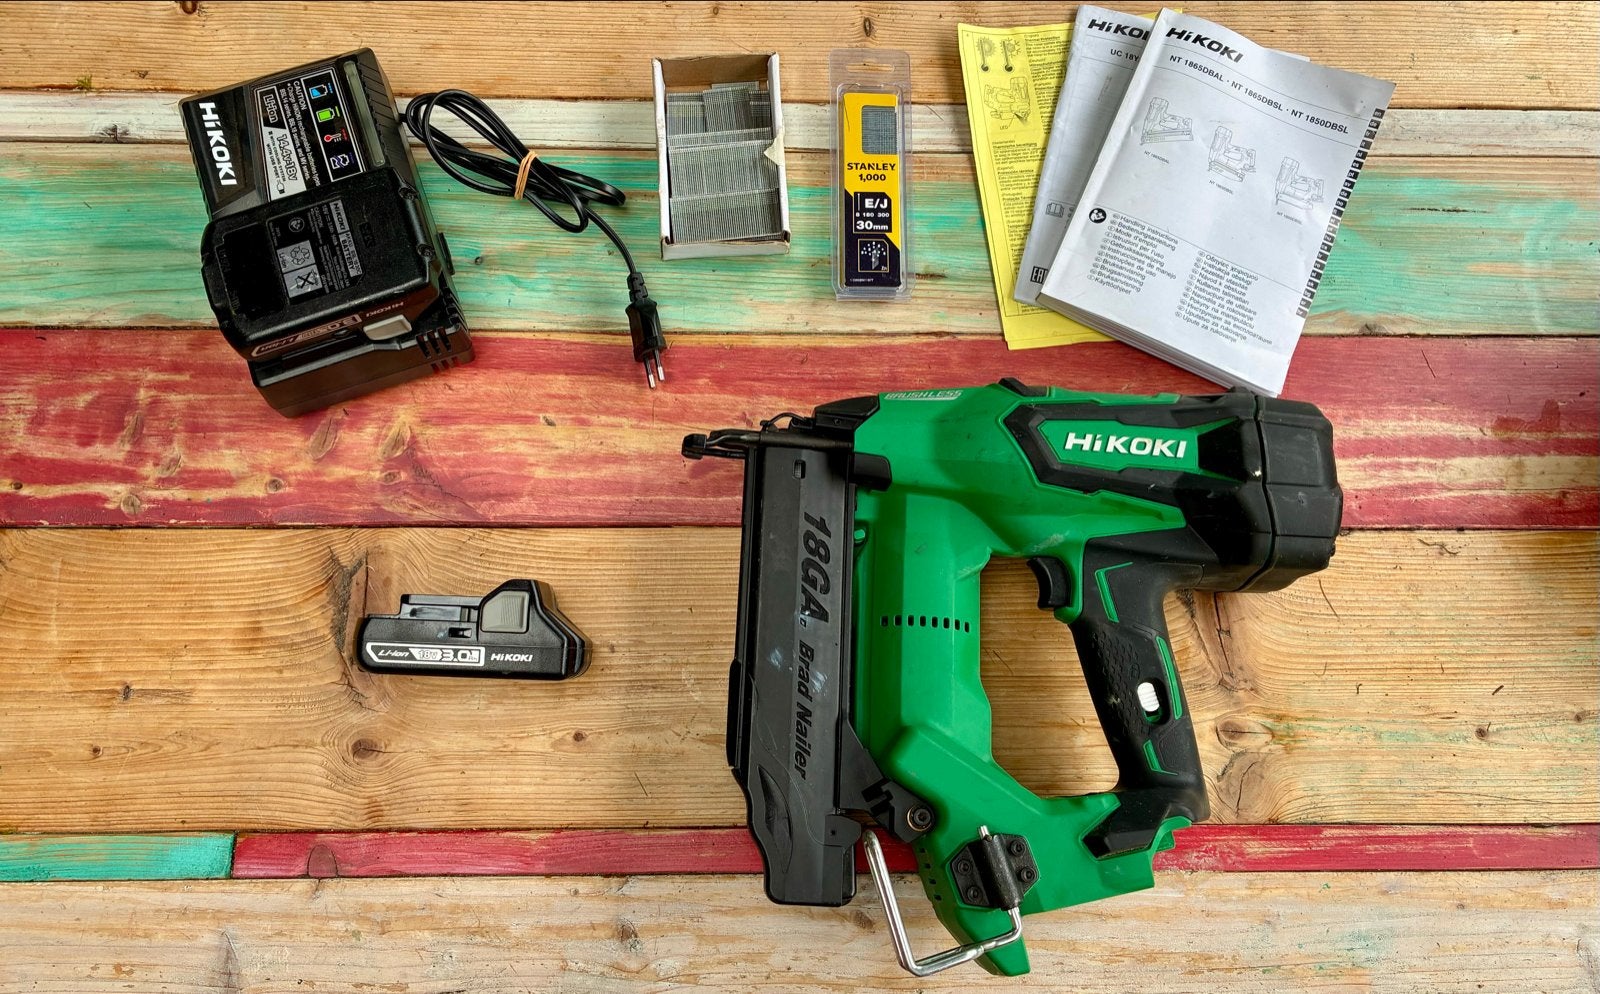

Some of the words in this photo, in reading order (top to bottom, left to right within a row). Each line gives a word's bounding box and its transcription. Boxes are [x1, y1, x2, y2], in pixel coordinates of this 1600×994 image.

[1110, 48, 1123, 57] UC
[1166, 27, 1244, 63] HiKOKI
[292, 80, 307, 110] CAUTION
[1169, 54, 1182, 63] NT
[1185, 59, 1224, 82] 1865DBAL
[1231, 80, 1244, 91] NT
[1244, 87, 1284, 111] 1865DBSL
[1290, 109, 1304, 120] NT
[1305, 114, 1349, 134] 1850DBSL
[263, 93, 279, 123] Li-ion
[199, 102, 237, 186] HiKOKI
[273, 146, 281, 165] COOLING
[278, 165, 286, 181] SYSTEM
[847, 162, 896, 170] STANLEY
[859, 174, 886, 182] 1,000
[865, 198, 888, 209] E/J
[856, 220, 888, 230] 30mm
[1115, 227, 1132, 238] Mode
[1119, 215, 1146, 230] Handling
[341, 239, 354, 270] BATTERY
[884, 390, 963, 400] BRUSHLESS
[1065, 432, 1187, 458] HiKOKI
[490, 653, 533, 662] HiKOKI
[799, 640, 814, 702] Brad
[795, 702, 812, 780] Nailer
